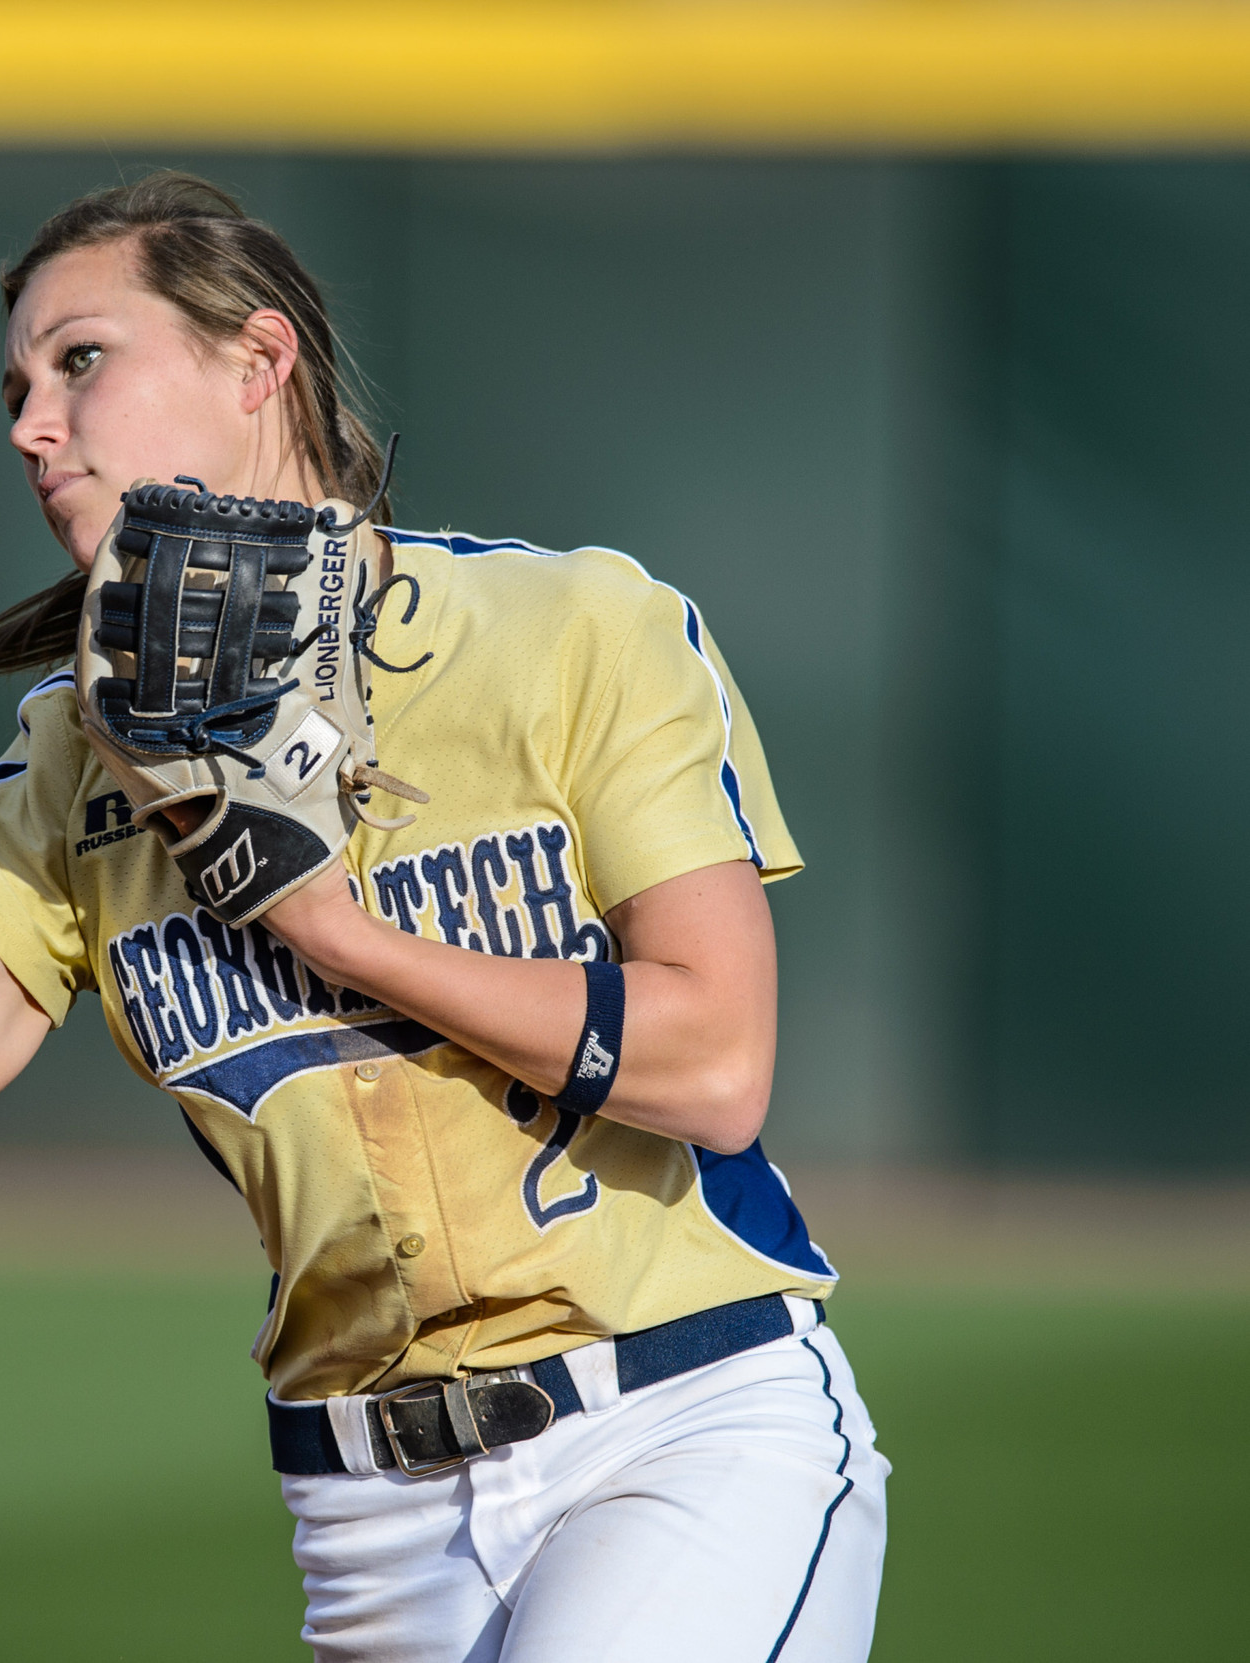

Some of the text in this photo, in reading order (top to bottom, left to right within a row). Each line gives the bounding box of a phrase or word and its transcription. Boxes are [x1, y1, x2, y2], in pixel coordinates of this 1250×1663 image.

[314, 537, 348, 703] LIONBERGER
[284, 741, 322, 781] 2
[75, 824, 148, 857] RUSSE
[369, 819, 605, 960] TECH
